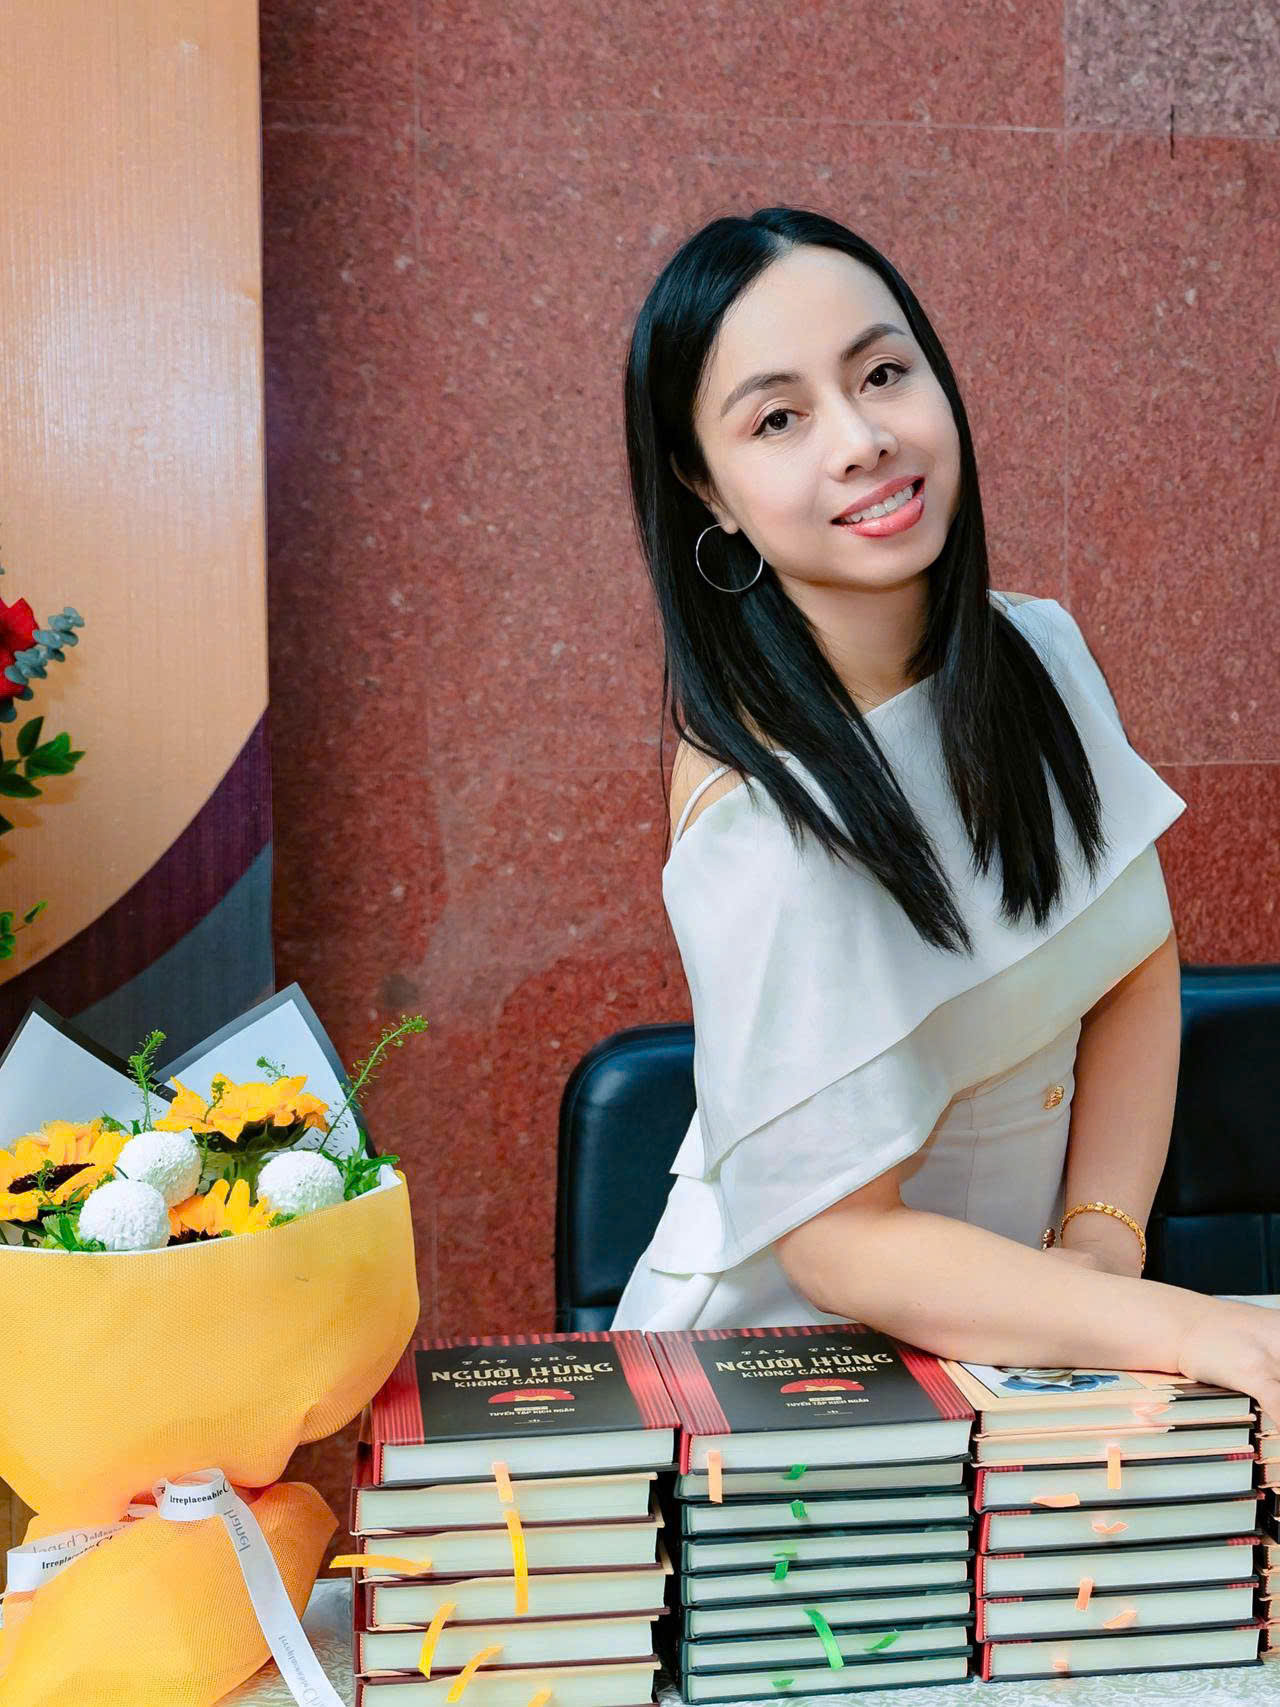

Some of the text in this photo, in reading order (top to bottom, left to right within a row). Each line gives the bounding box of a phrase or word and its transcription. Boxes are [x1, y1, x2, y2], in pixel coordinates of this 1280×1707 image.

[432, 1362, 614, 1382] NGƯỜI HÙNG
[715, 1353, 894, 1372] NGƯỜI HÙNG
[170, 1489, 223, 1505] Irreplaceable
